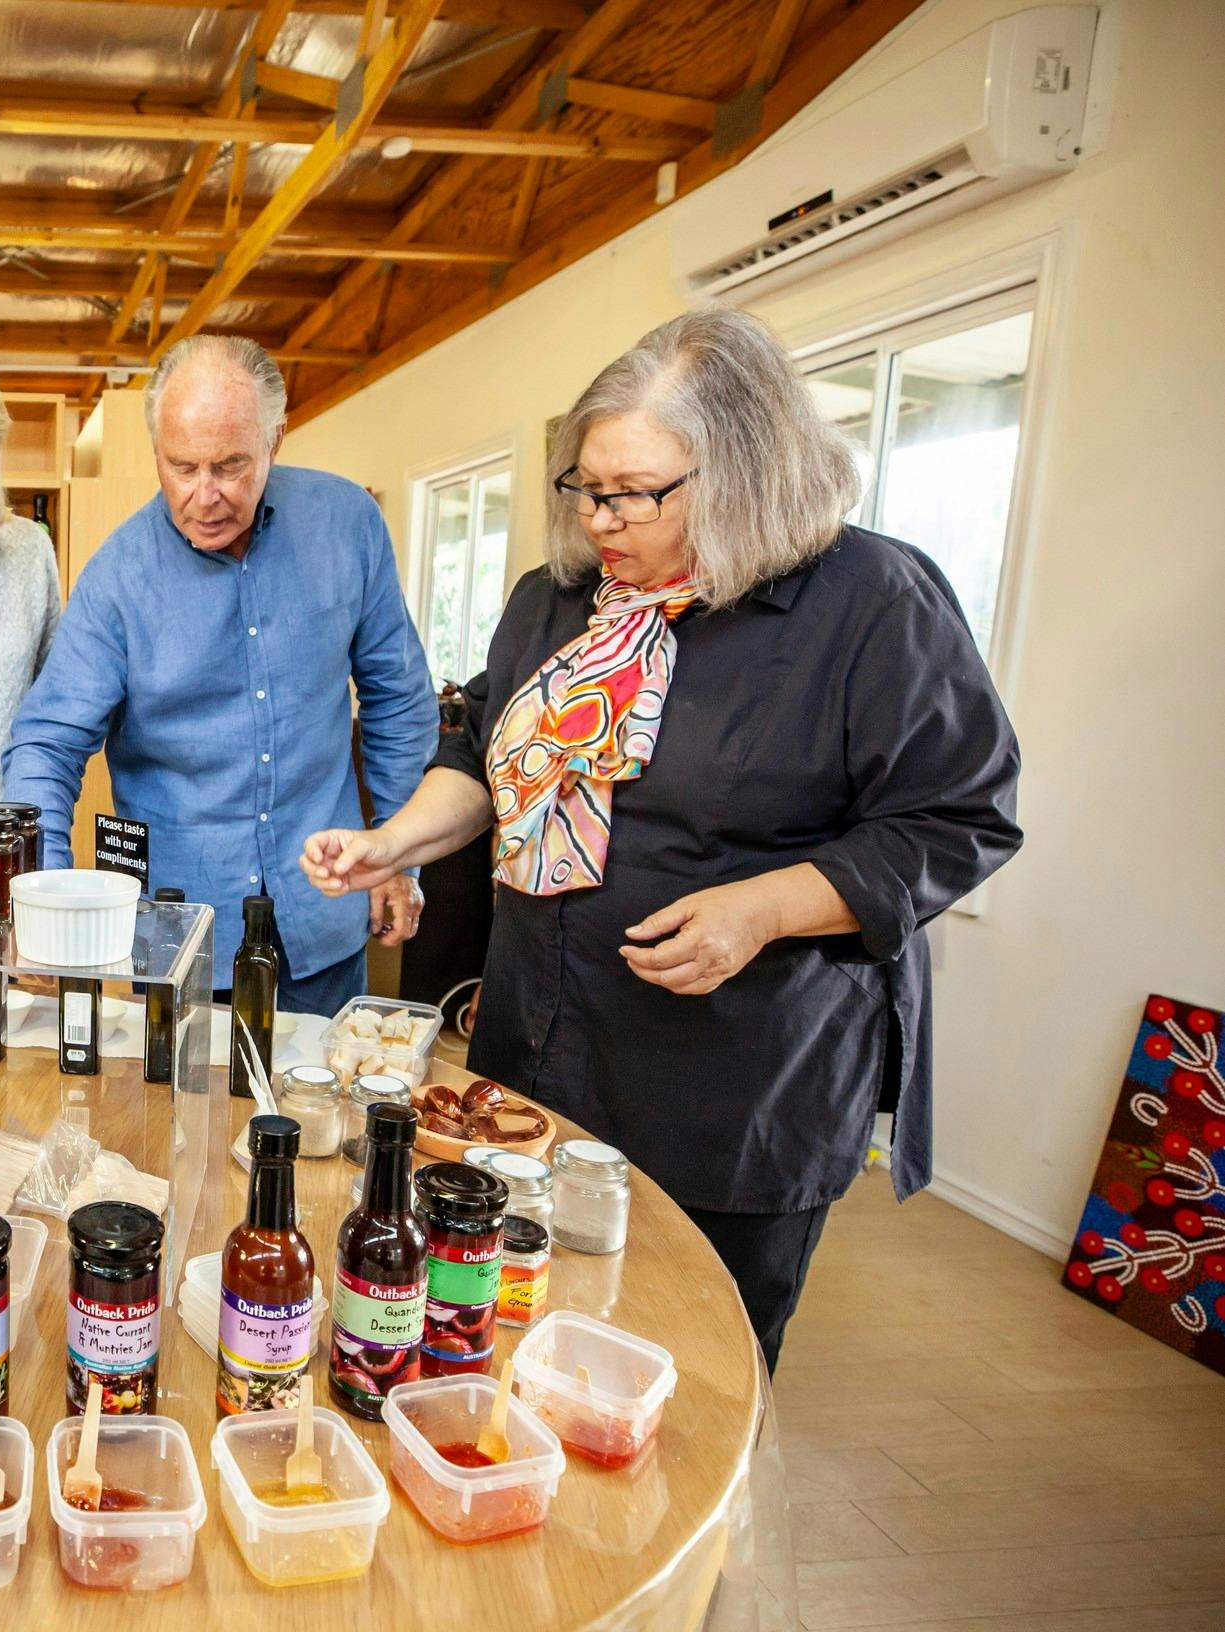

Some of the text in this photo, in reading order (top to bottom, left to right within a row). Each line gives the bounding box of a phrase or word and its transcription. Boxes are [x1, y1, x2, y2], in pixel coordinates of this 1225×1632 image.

[98, 816, 146, 837] Please taste
[105, 834, 137, 851] with our
[96, 850, 147, 871] compliments
[369, 1285, 418, 1300] Outback
[77, 1296, 156, 1320] Outback Pride
[237, 1298, 288, 1319] Outback
[384, 1301, 424, 1318] Quando
[81, 1318, 151, 1337] Native Currant
[239, 1320, 277, 1339] Desert
[370, 1319, 411, 1333] Dessert
[78, 1331, 153, 1355] & Muntries Jam
[265, 1343, 292, 1356] Syrup
